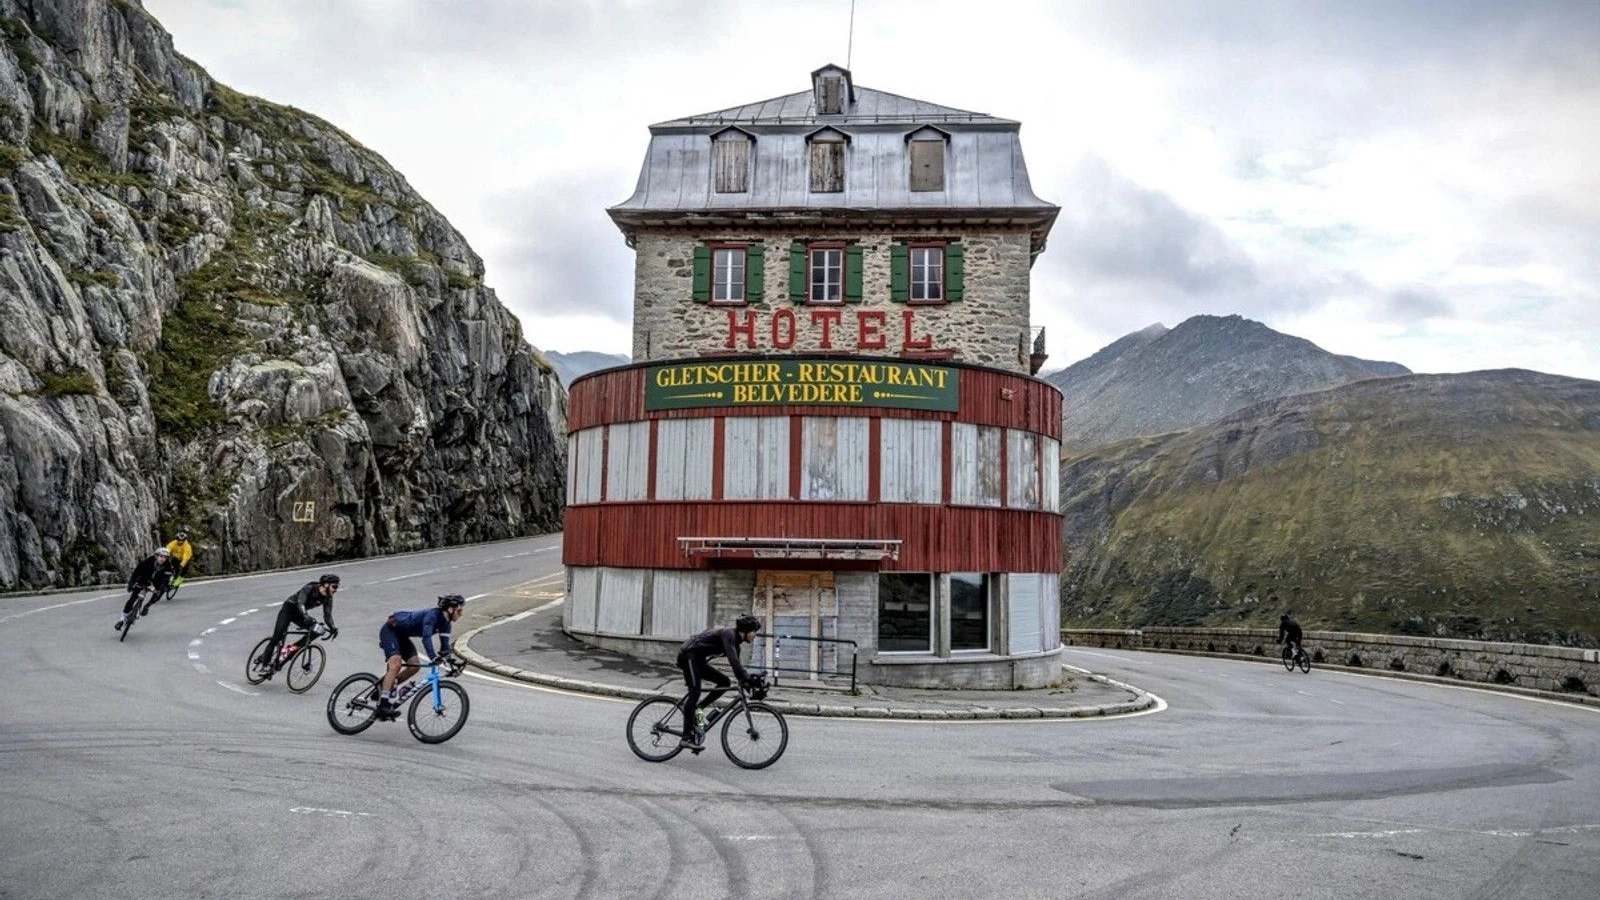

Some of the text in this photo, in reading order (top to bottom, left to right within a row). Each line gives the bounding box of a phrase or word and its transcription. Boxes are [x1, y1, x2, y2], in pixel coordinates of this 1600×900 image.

[726, 308, 932, 349] HOTEL
[656, 363, 781, 387] GLETSCHER
[799, 364, 949, 389] RESTAURANT
[733, 384, 863, 403] BELVEDERE
